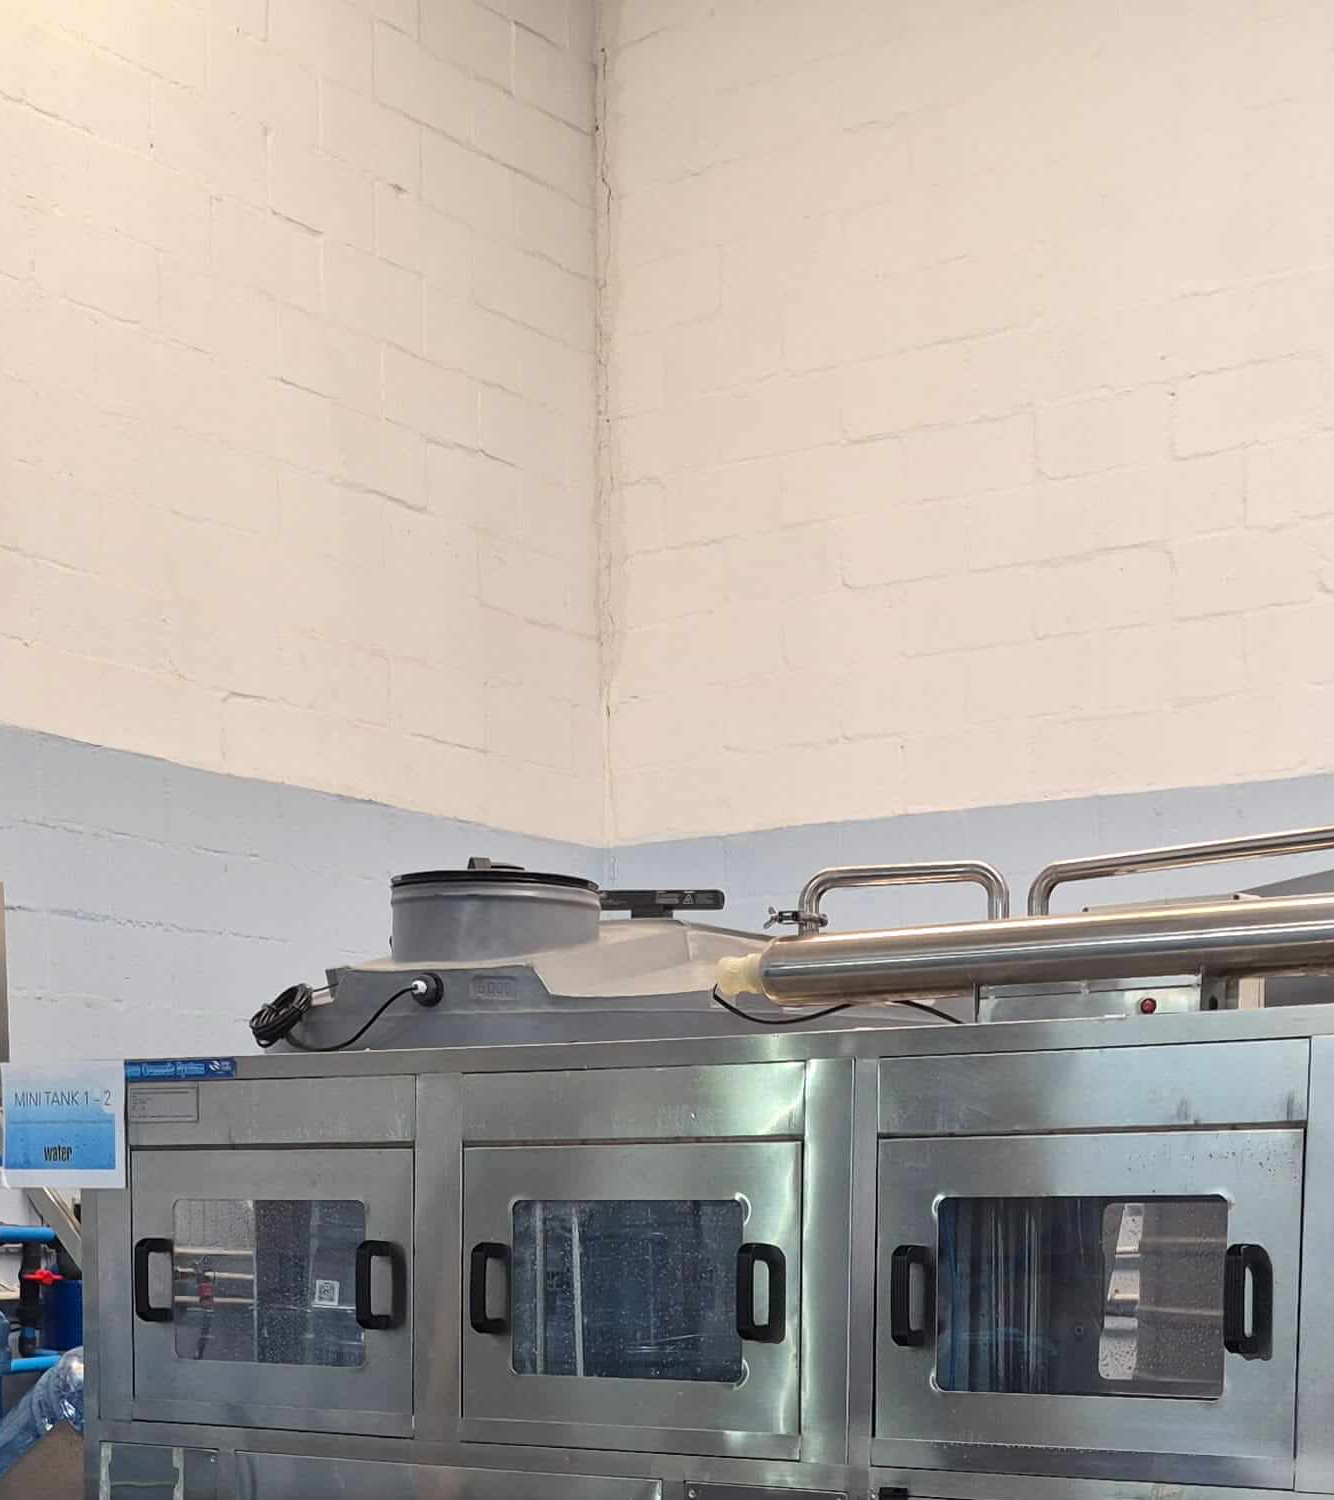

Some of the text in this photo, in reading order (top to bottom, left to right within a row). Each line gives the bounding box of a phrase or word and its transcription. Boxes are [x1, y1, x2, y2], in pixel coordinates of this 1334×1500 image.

[14, 1091, 42, 1107] MINI
[43, 1091, 79, 1106] TANK
[84, 1091, 90, 1105] 1
[103, 1090, 111, 1105] 2
[43, 1144, 73, 1162] water
